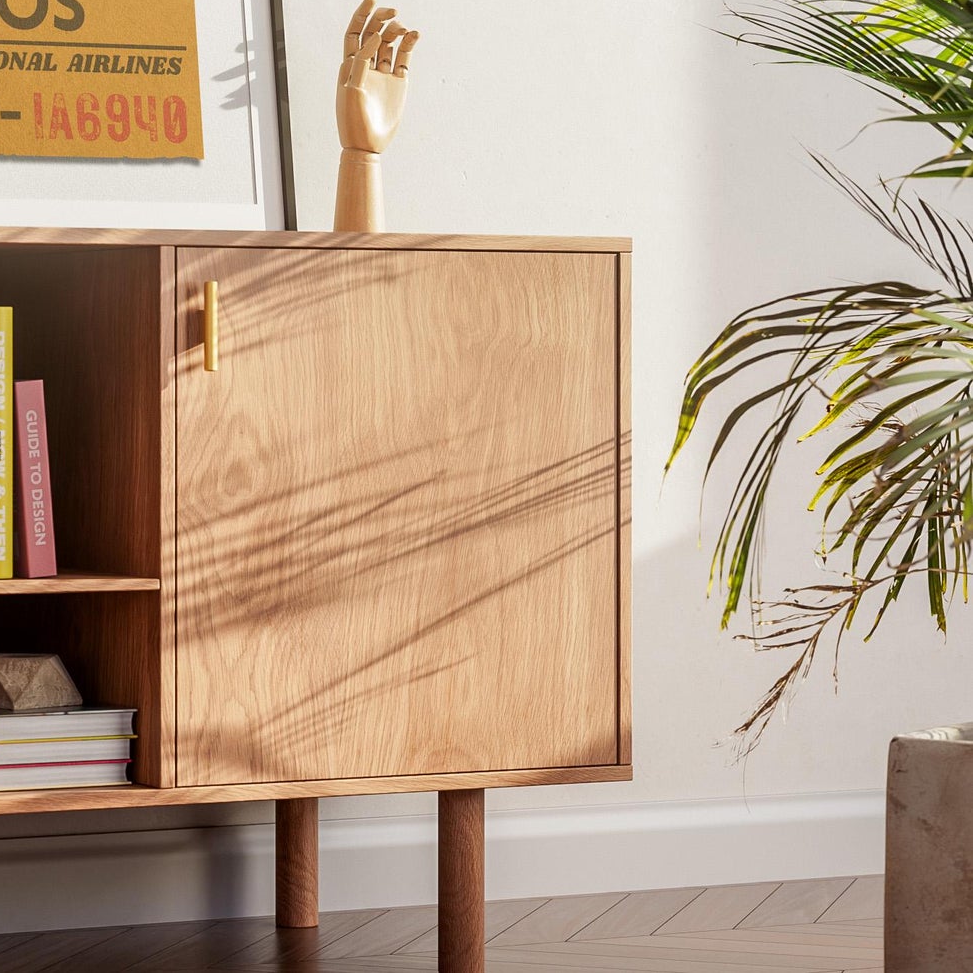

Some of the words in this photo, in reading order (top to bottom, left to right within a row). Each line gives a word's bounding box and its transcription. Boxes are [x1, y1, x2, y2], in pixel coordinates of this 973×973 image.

[66, 53, 183, 76] AIRLINES
[26, 409, 40, 459] GUIDE
[30, 462, 42, 485] TO
[31, 488, 46, 546] DESIGN
